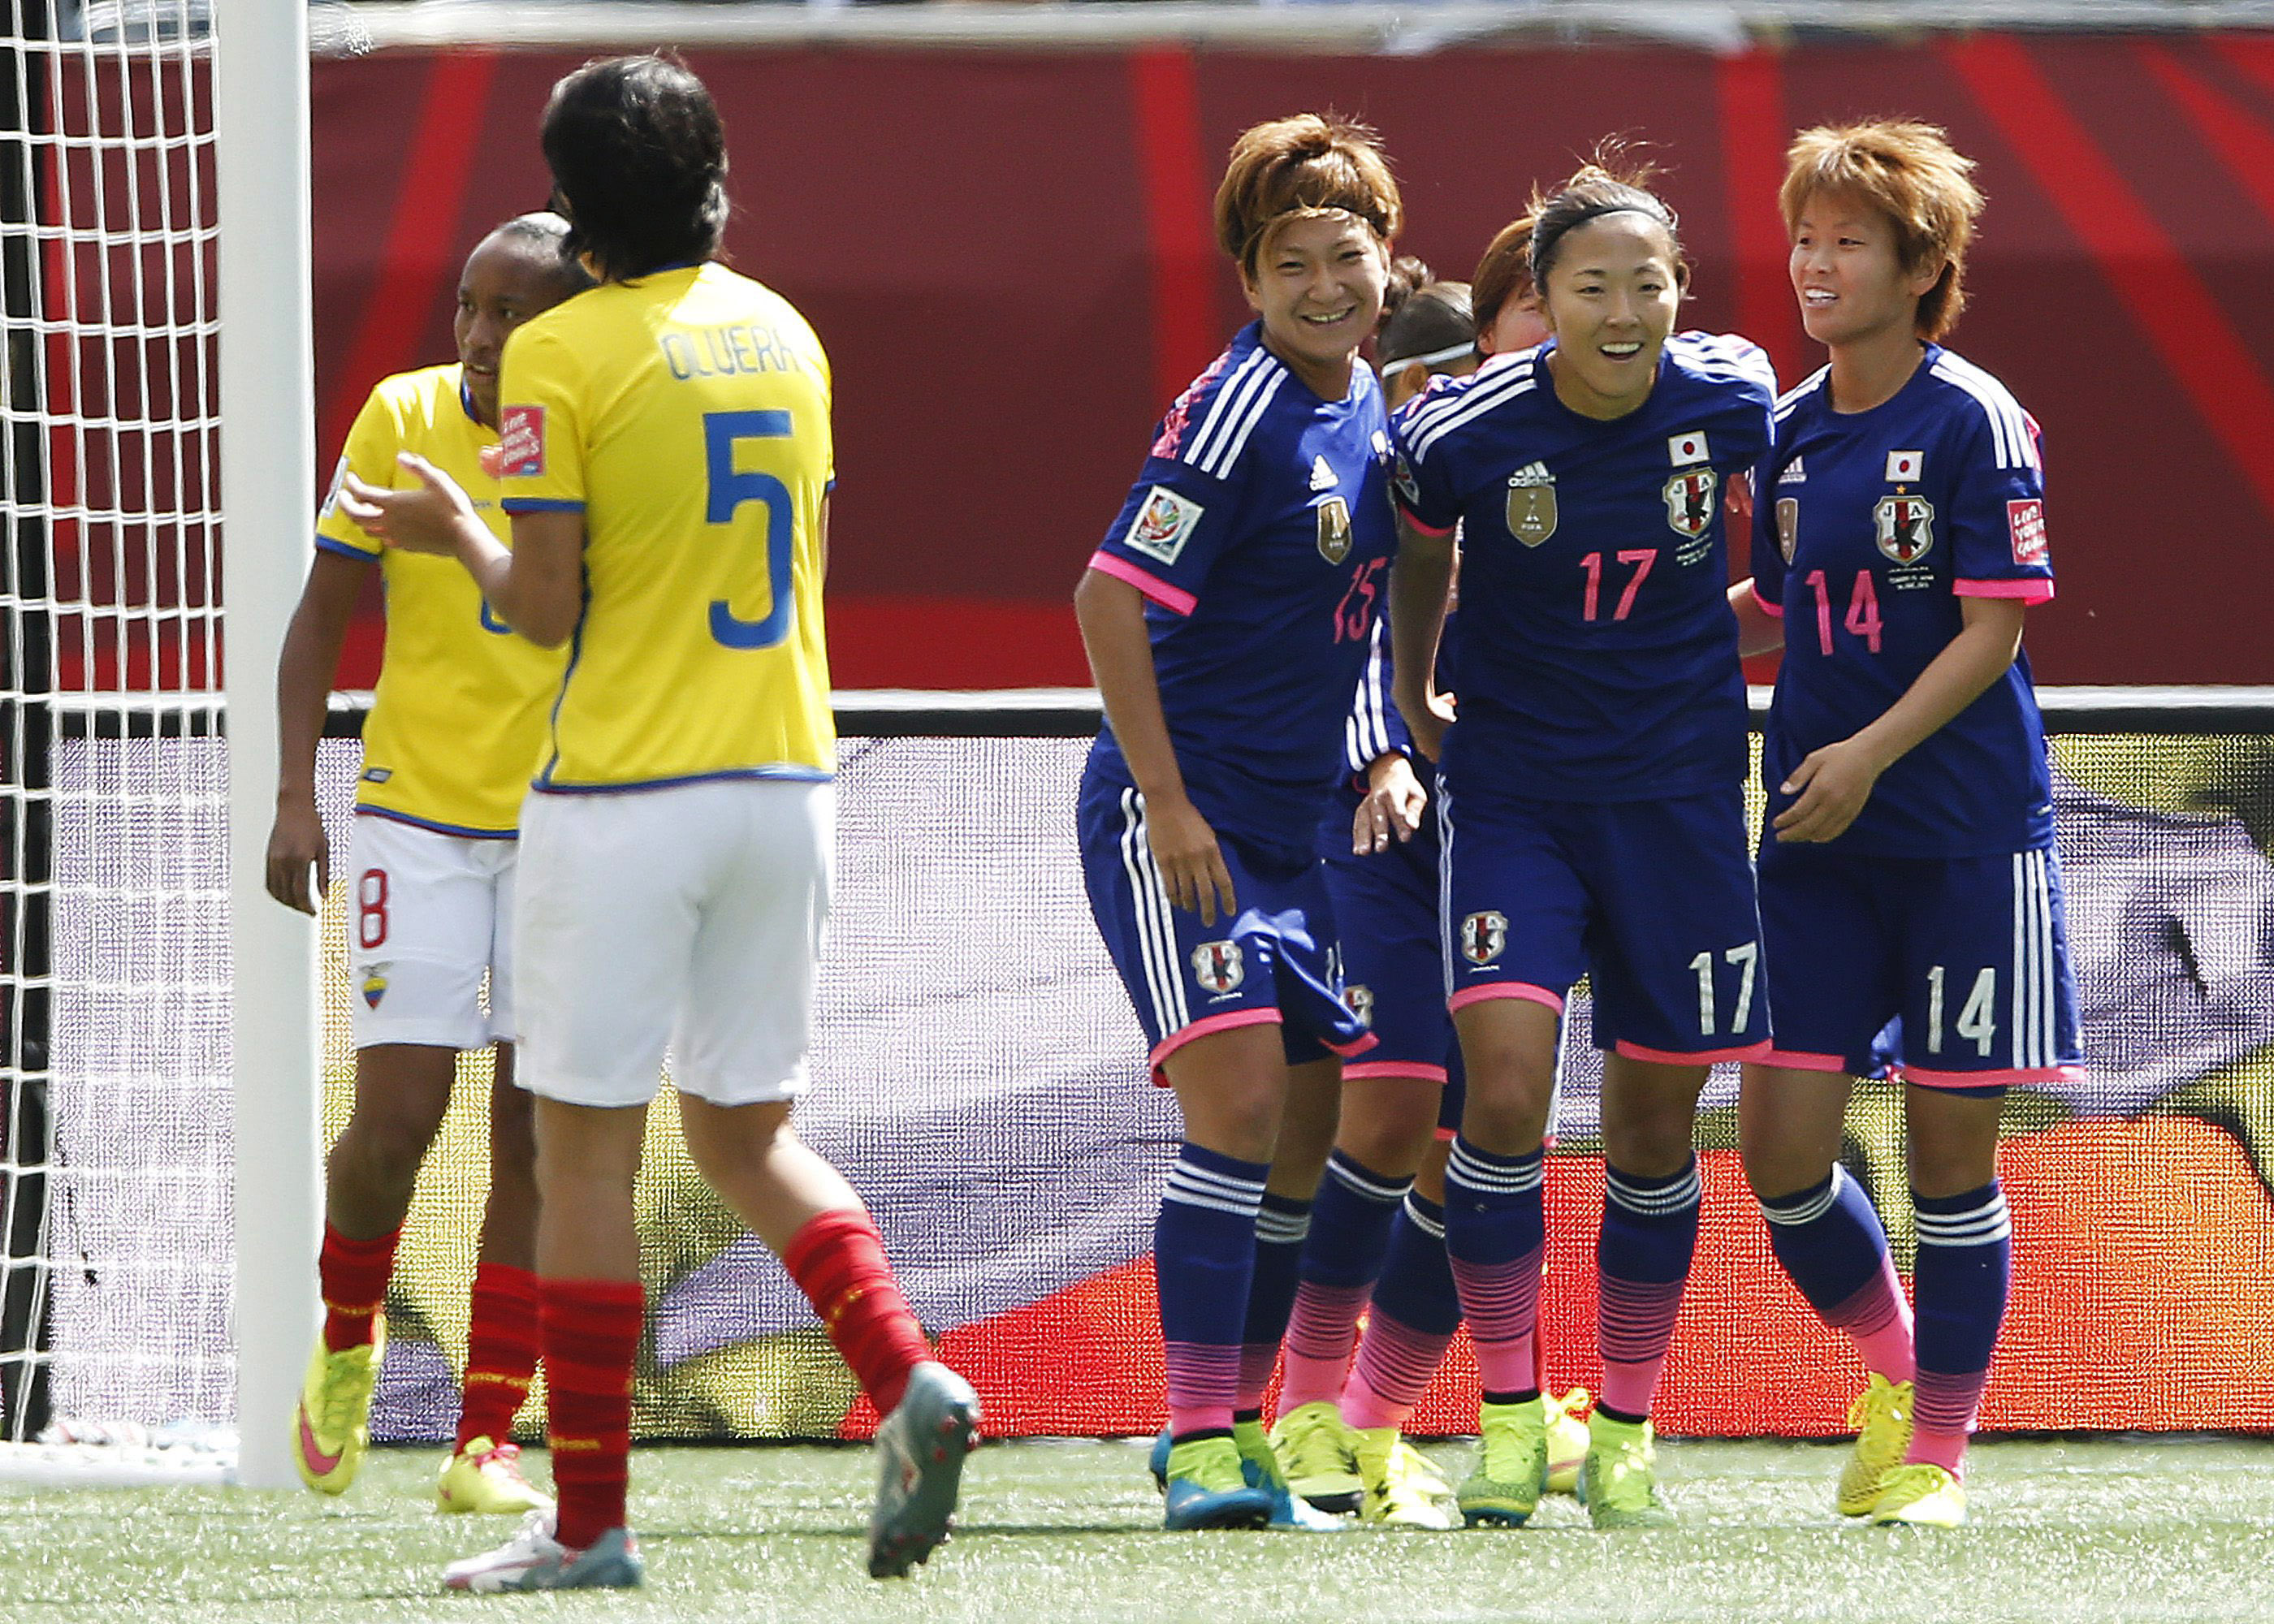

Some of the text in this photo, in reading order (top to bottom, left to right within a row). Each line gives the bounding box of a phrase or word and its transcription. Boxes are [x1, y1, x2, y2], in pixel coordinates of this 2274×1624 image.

[703, 409, 793, 650] 5
[1334, 557, 1388, 645] 15
[1580, 548, 1658, 622] 17
[1805, 569, 1884, 656] 14
[359, 869, 388, 949] 8
[1688, 940, 1757, 1036] 17
[1926, 965, 1997, 1057] 14
